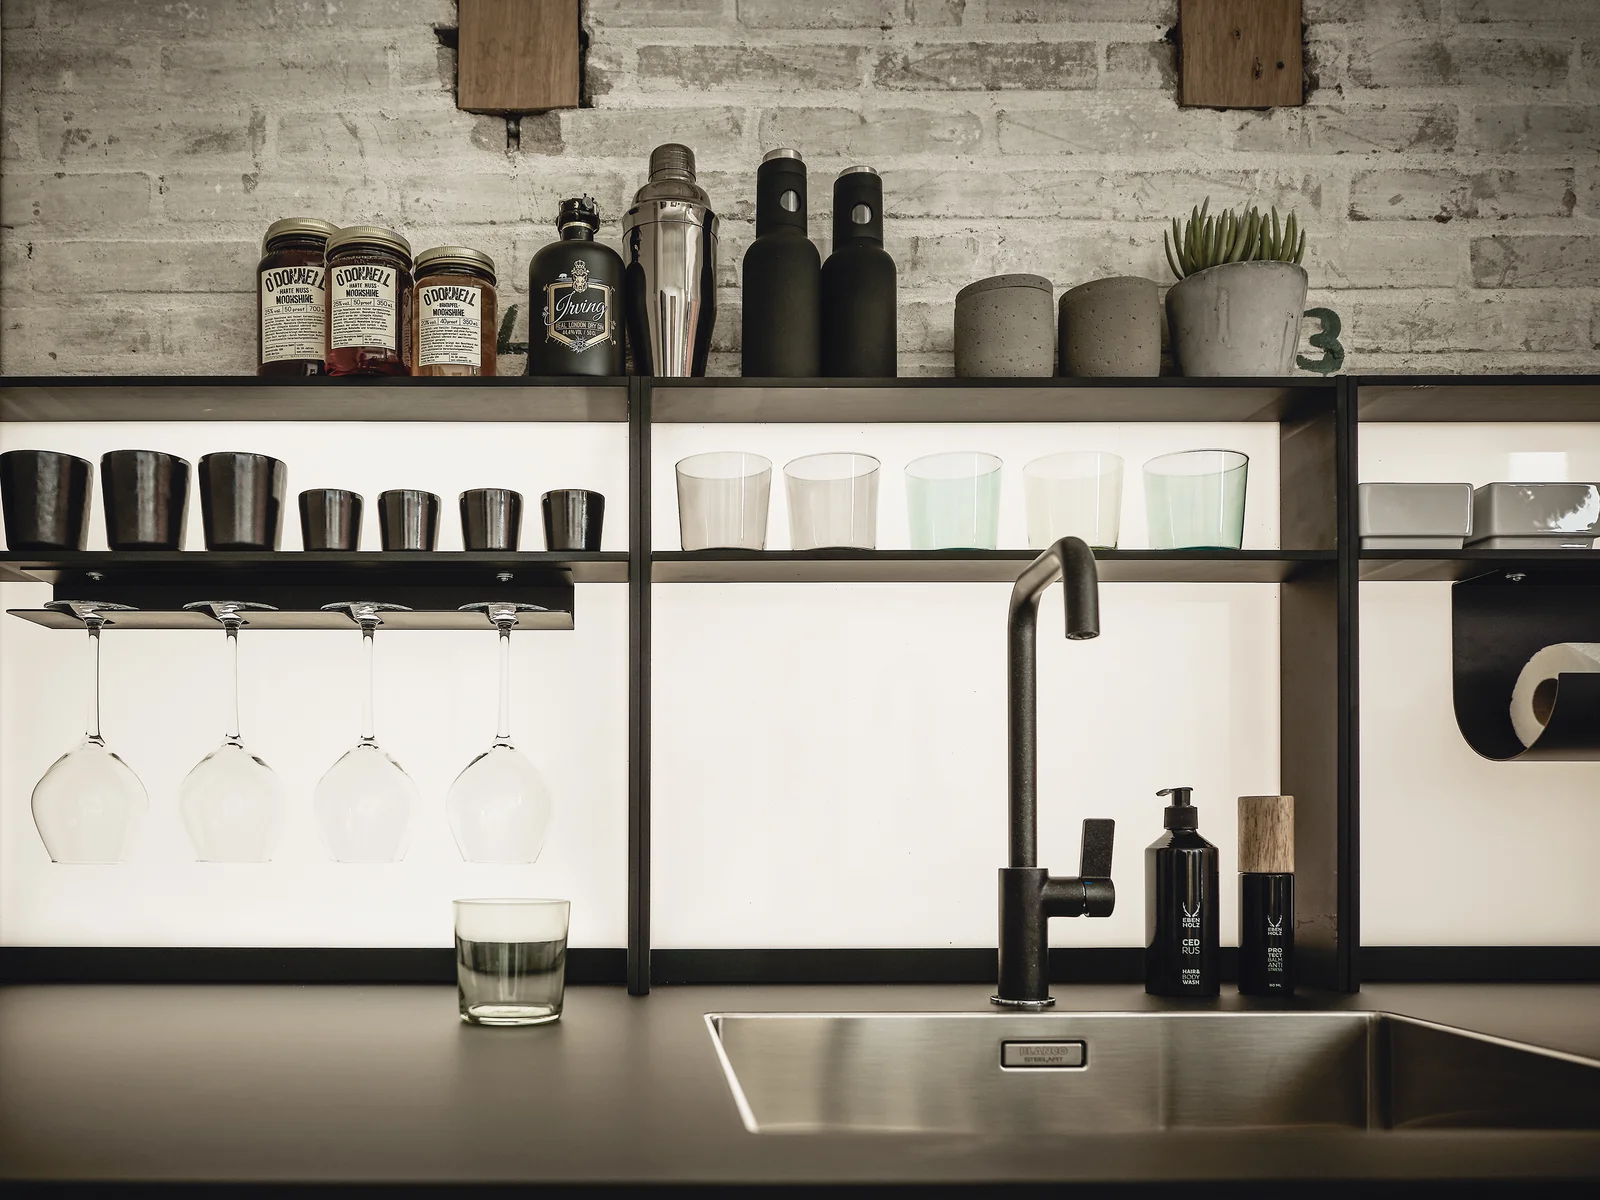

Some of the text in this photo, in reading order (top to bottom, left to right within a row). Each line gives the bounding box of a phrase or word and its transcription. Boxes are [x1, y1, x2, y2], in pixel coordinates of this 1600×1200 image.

[336, 266, 390, 288] O'DONNELL
[346, 289, 380, 298] MOONSHINE
[424, 286, 476, 306] O'DONNELL
[276, 294, 314, 304] MOONSHINE
[433, 308, 465, 316] MOONSHINE
[544, 290, 608, 326] Irving
[1296, 308, 1345, 374] 3
[1182, 946, 1200, 954] RUS
[1020, 1047, 1068, 1055] BLANCO
